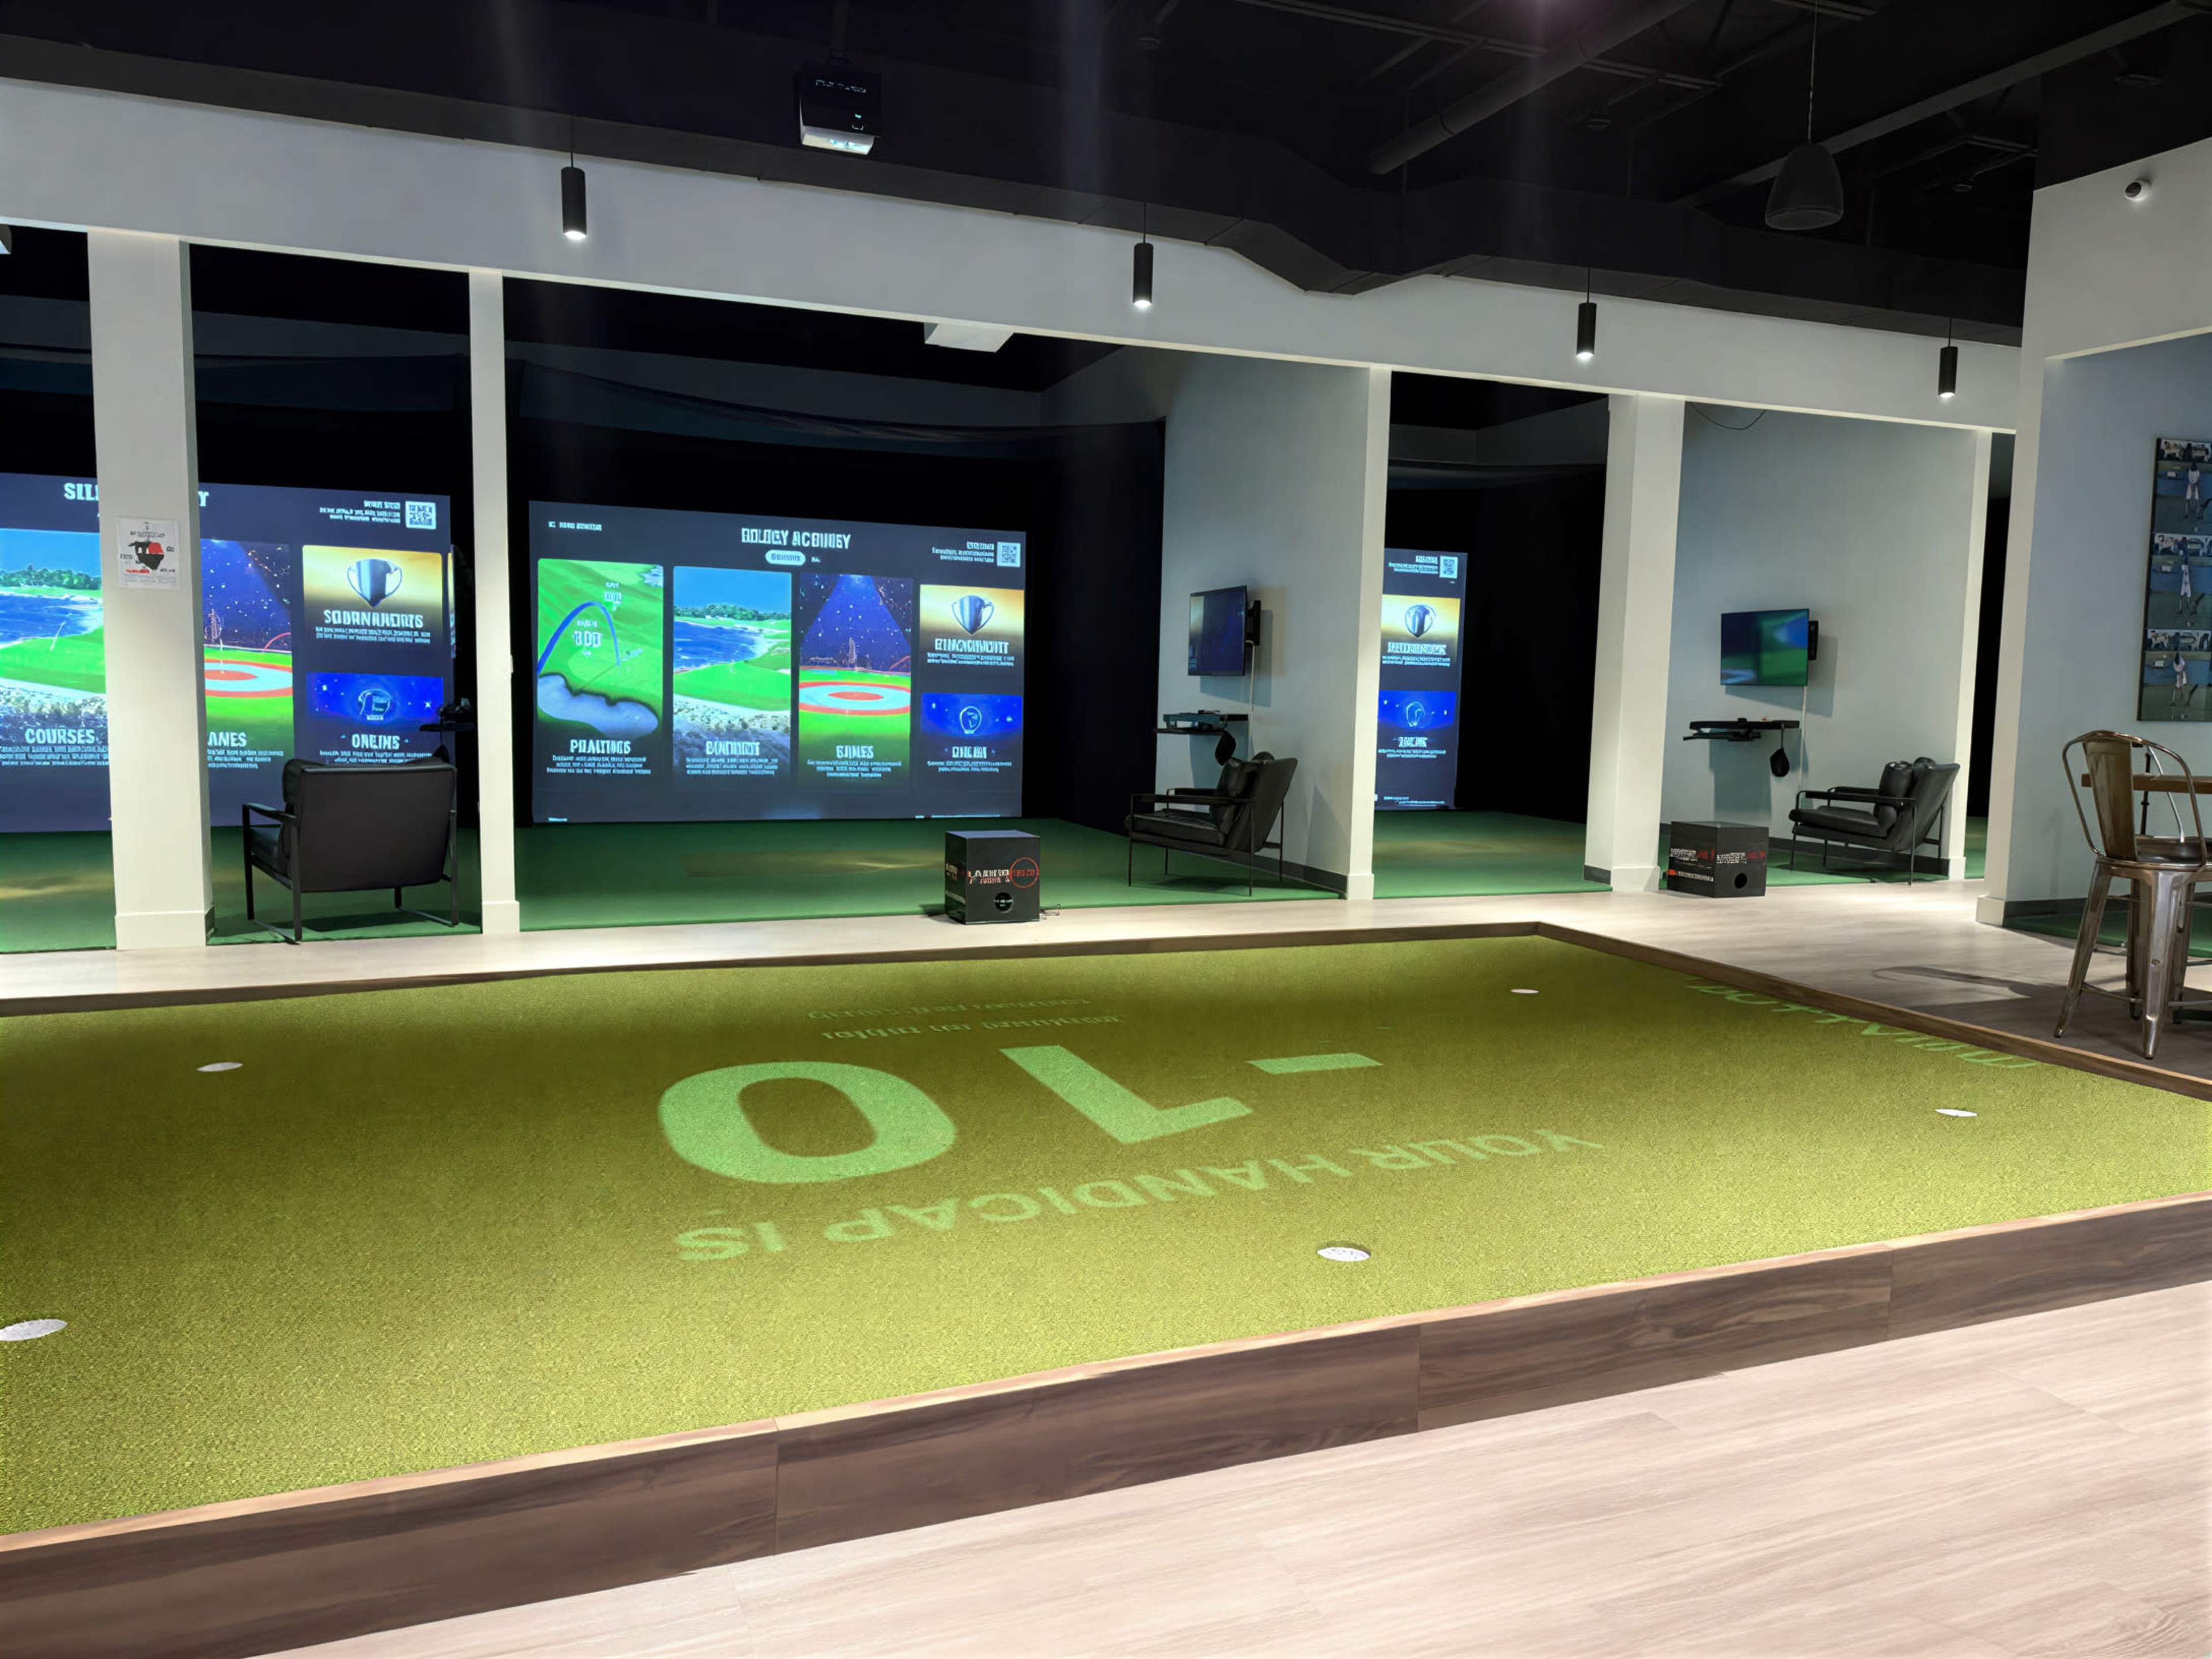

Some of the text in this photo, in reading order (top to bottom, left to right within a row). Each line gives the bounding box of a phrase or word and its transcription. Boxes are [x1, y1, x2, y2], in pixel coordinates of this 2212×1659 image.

[25, 728, 95, 744] COURSES
[675, 1128, 1604, 1262] YOUR HANDICAP IS
